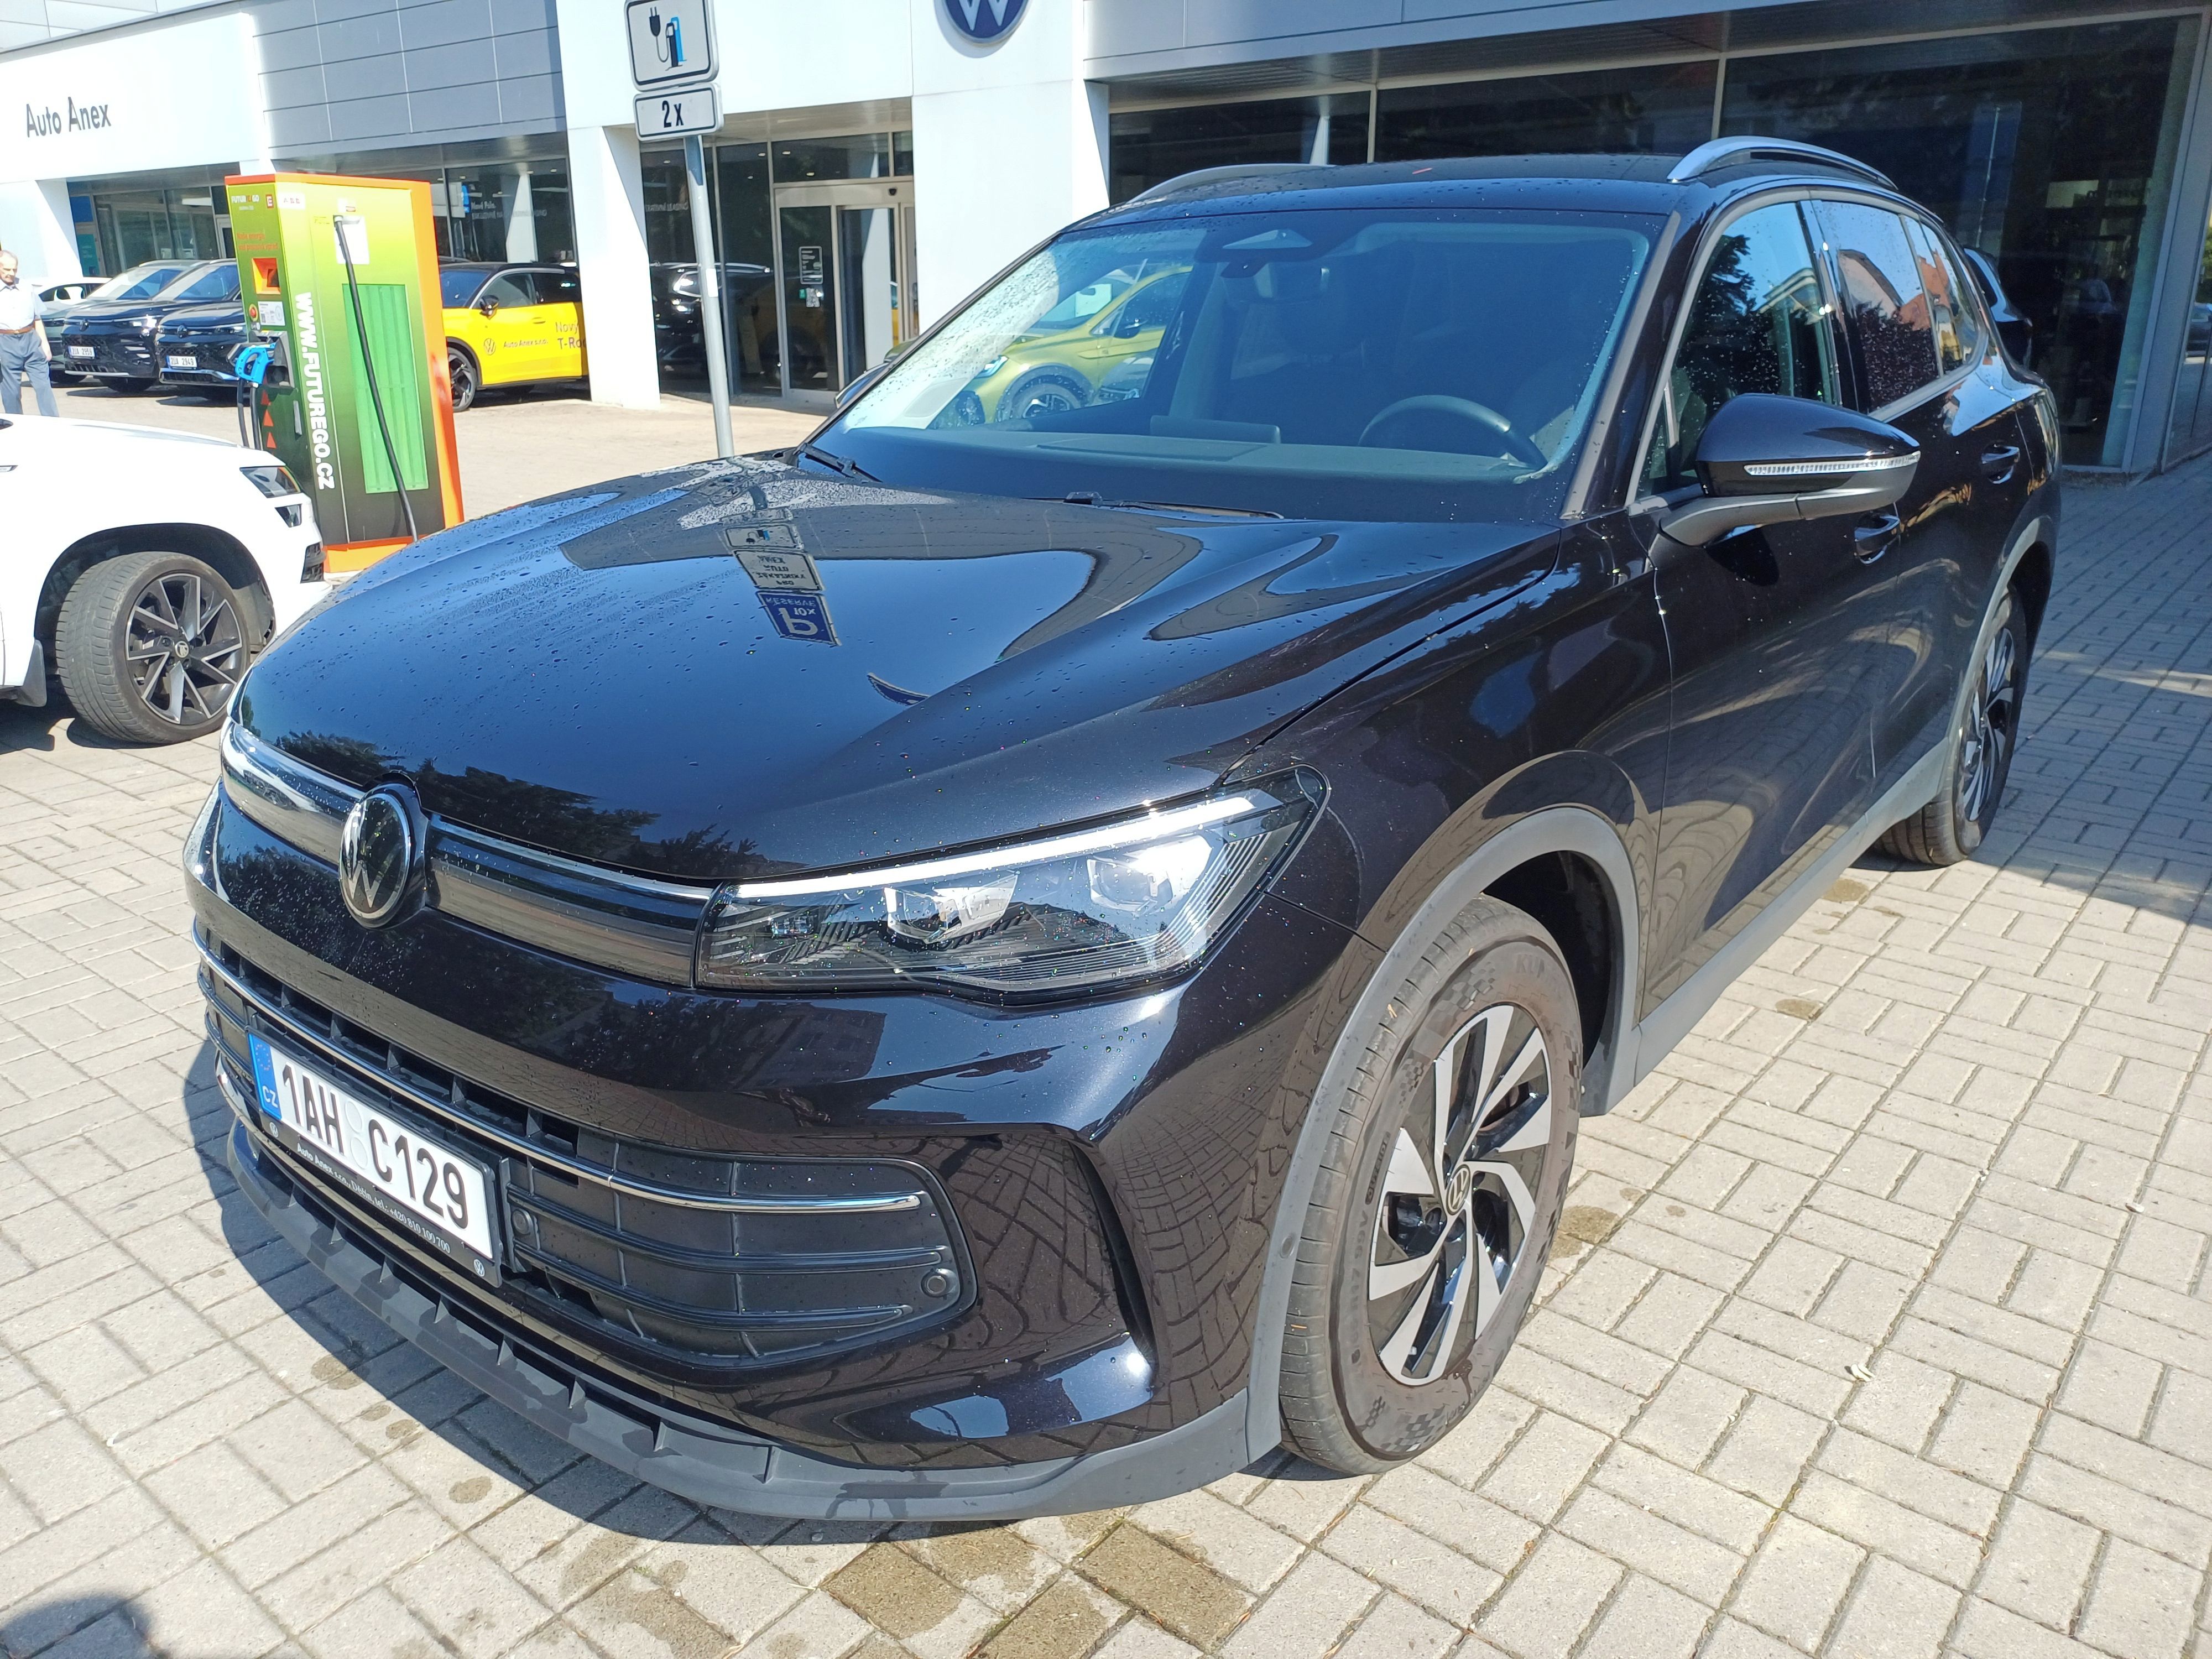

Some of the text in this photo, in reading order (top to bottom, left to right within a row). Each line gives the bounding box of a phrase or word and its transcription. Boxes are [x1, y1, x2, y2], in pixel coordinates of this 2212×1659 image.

[26, 96, 112, 138] Auto Anex
[555, 320, 579, 334] Nový
[295, 292, 335, 490] WWW.FUTUREGO.CZ
[262, 1085, 278, 1108] CZ
[283, 1063, 469, 1230] 1AH C129
[297, 1142, 314, 1161] Auto
[315, 1154, 334, 1175] Anex
[375, 1197, 389, 1213] tel.:
[389, 1206, 408, 1224] +420
[407, 1218, 421, 1234] 810
[422, 1227, 436, 1244] 100
[436, 1237, 450, 1254] 700
